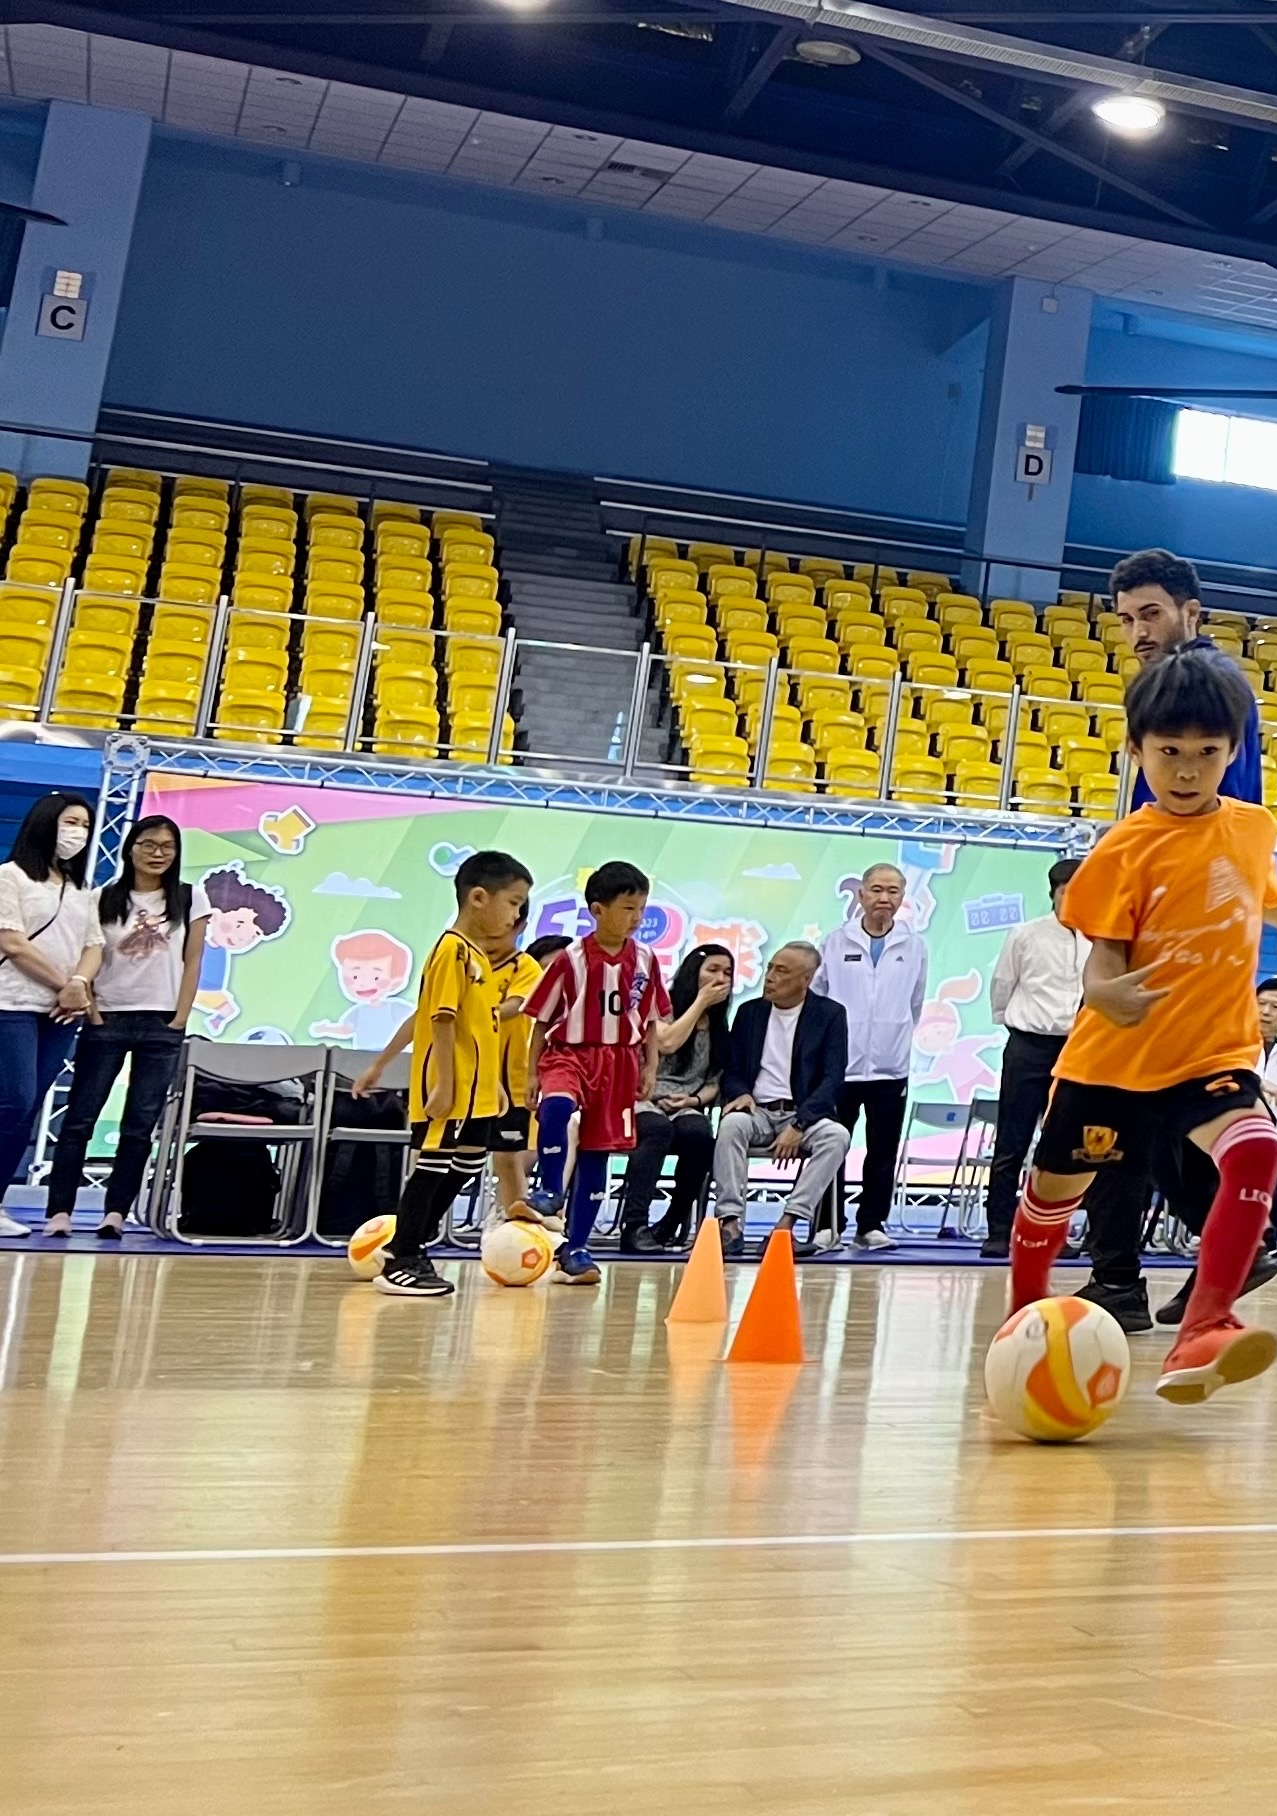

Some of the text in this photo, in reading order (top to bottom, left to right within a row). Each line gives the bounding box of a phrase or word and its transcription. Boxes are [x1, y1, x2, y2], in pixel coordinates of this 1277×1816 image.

[50, 305, 76, 330] C
[1024, 454, 1044, 476] D
[598, 990, 626, 1017] 10
